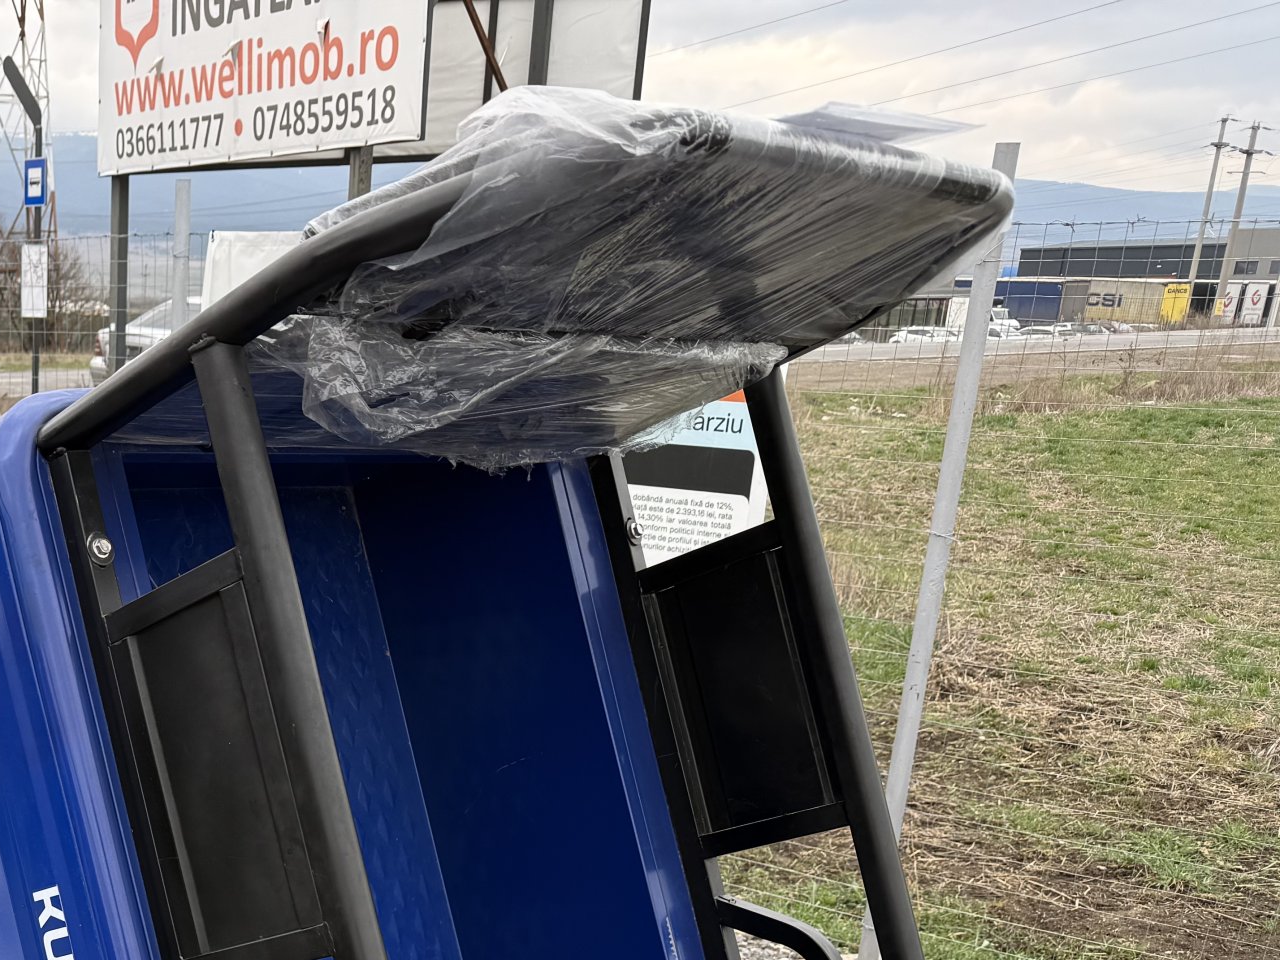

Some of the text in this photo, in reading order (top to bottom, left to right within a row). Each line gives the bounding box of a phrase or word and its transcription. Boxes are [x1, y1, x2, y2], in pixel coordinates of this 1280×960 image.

[114, 19, 399, 117] www.wellimob.ro
[115, 84, 396, 159] 0366111777 0748559518
[632, 493, 664, 503] dobândă
[665, 496, 688, 506] anuală
[690, 499, 703, 507] fixă
[704, 501, 715, 509] de
[648, 505, 663, 513] este
[677, 518, 708, 527] valoarea
[710, 520, 732, 529] totală
[641, 524, 668, 532] onform
[669, 526, 695, 536] politicii
[696, 529, 722, 538] interne
[658, 534, 667, 542] de
[667, 536, 693, 545] profilul
